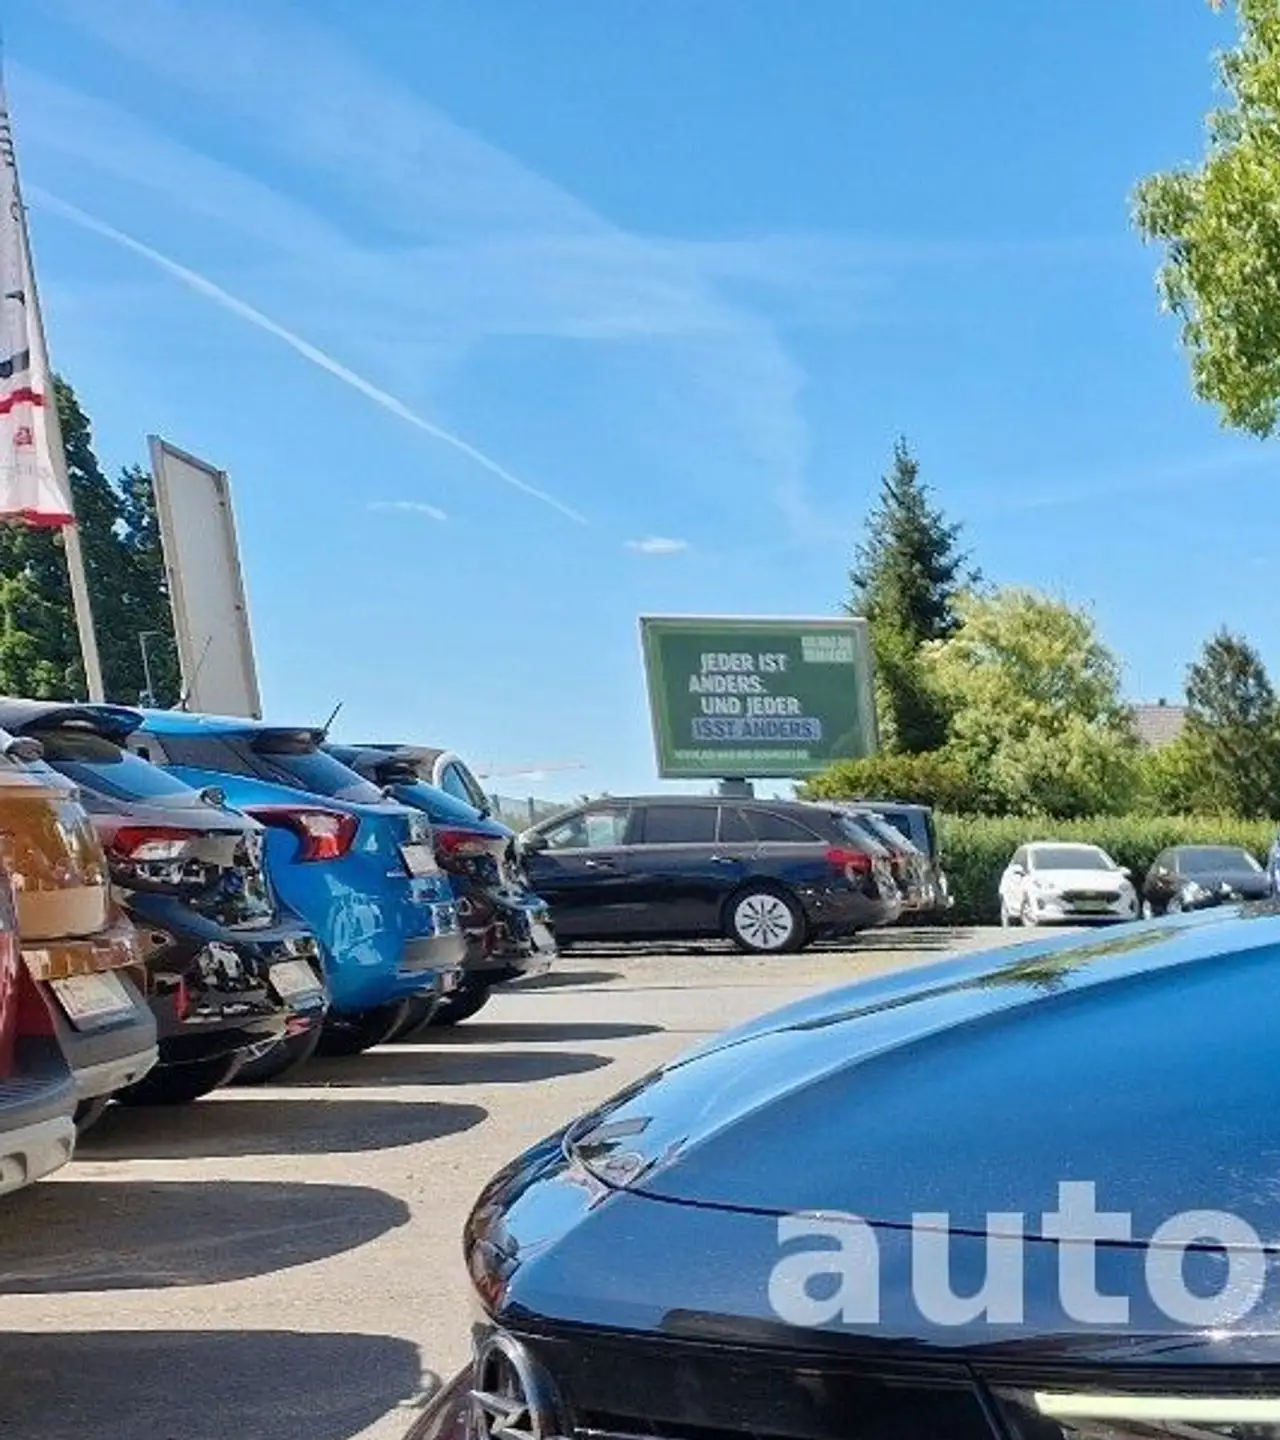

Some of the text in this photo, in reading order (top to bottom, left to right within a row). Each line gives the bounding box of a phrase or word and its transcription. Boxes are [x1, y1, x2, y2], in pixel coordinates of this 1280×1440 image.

[701, 652, 787, 673] JEDER IST
[689, 674, 767, 693] ANDERS.
[701, 696, 800, 716] UND JEDER
[696, 719, 737, 738] ISST
